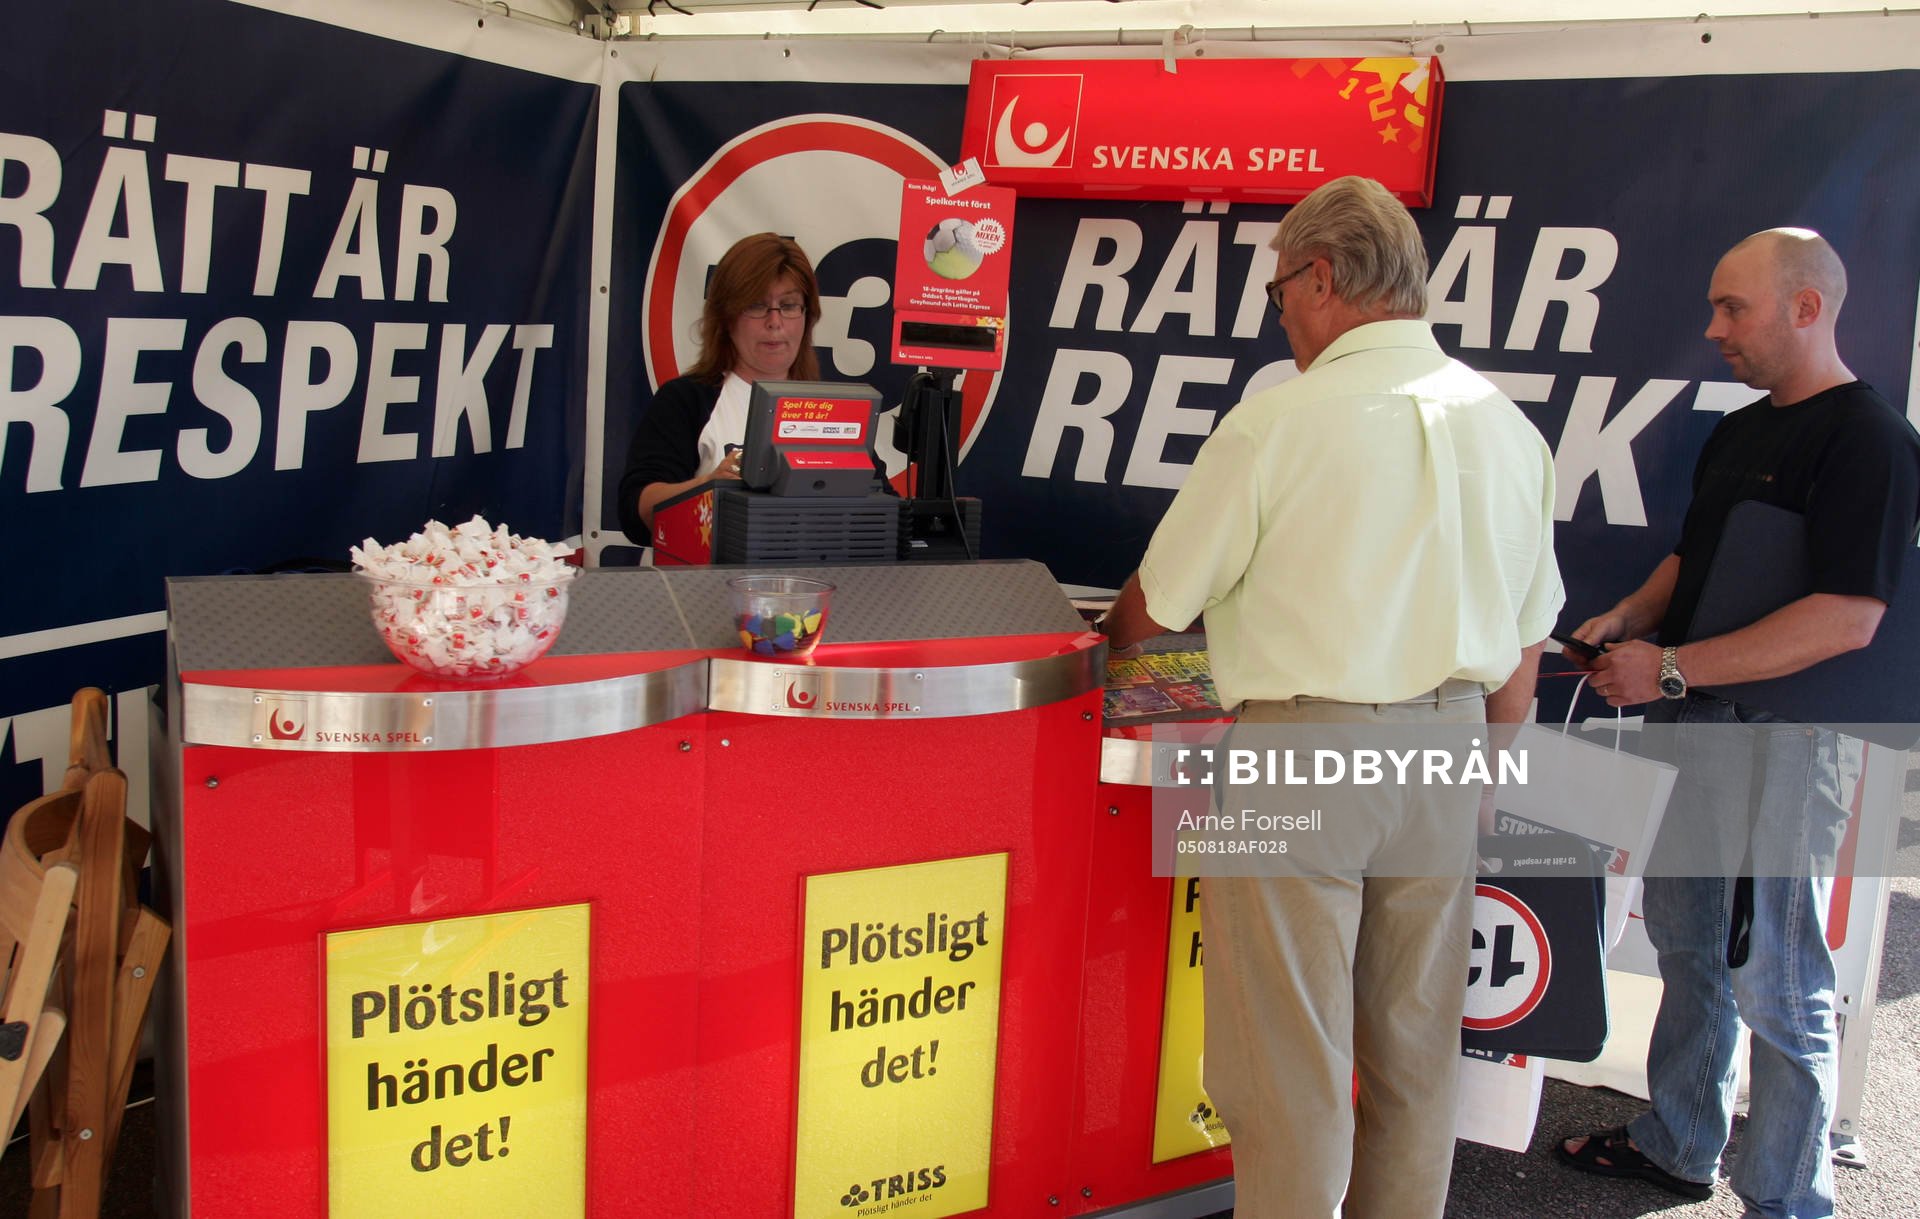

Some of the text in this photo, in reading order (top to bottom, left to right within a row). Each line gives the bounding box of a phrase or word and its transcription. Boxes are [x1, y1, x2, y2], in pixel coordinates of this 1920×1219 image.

[1092, 145, 1325, 173] SVENSKA SPEL
[0, 109, 457, 303] RÄTT ÄR
[926, 196, 991, 209] Spelkortet först
[976, 231, 1000, 242] MIXEN
[980, 223, 998, 233] LIRA
[1049, 195, 1619, 353] RÄT ÄR
[0, 316, 555, 494] RESPEKT
[781, 411, 801, 419] över
[783, 401, 833, 411] Spel för dig
[826, 701, 911, 712] SVENSKA SPEL
[315, 731, 421, 743] SVENSKA SPEL
[1513, 858, 1542, 867] respekt
[821, 910, 990, 969] Plötsligt
[351, 967, 570, 1039] Plötsligt
[830, 975, 976, 1032] händer
[367, 1043, 555, 1111] händer
[860, 1039, 940, 1089] det!
[410, 1115, 511, 1173] det!
[871, 1164, 947, 1202] TRISS
[857, 1193, 932, 1218] Plötsligt händer det
